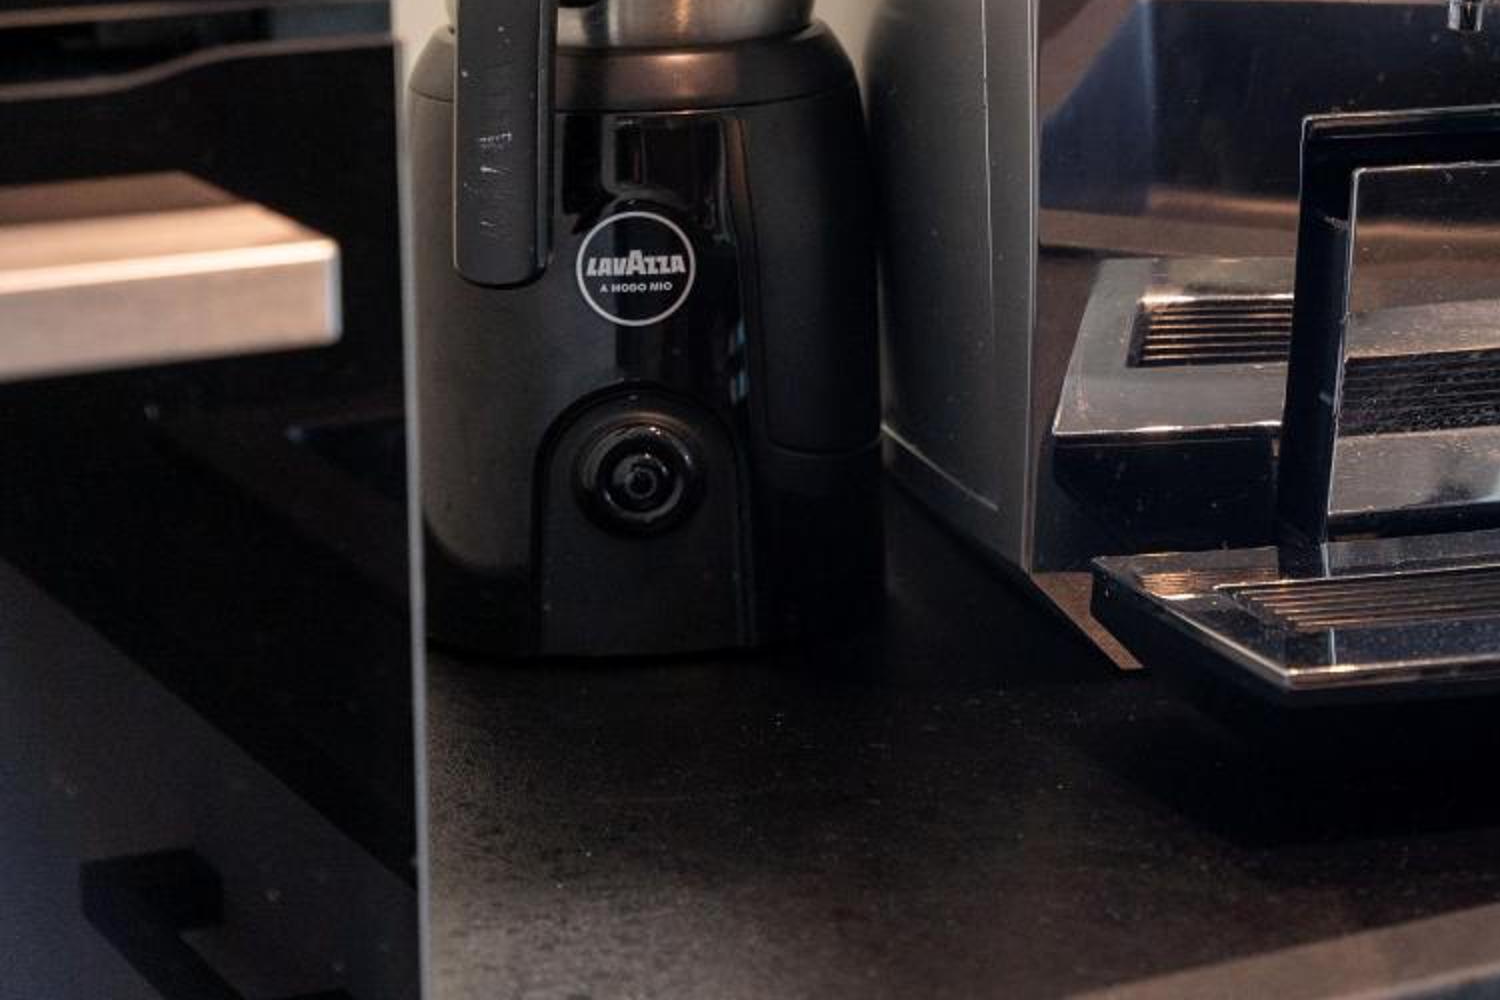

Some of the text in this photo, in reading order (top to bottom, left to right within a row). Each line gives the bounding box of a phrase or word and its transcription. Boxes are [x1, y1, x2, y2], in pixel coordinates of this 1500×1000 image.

[586, 249, 687, 277] LAVAZZA
[600, 281, 673, 293] A MODO MIO
